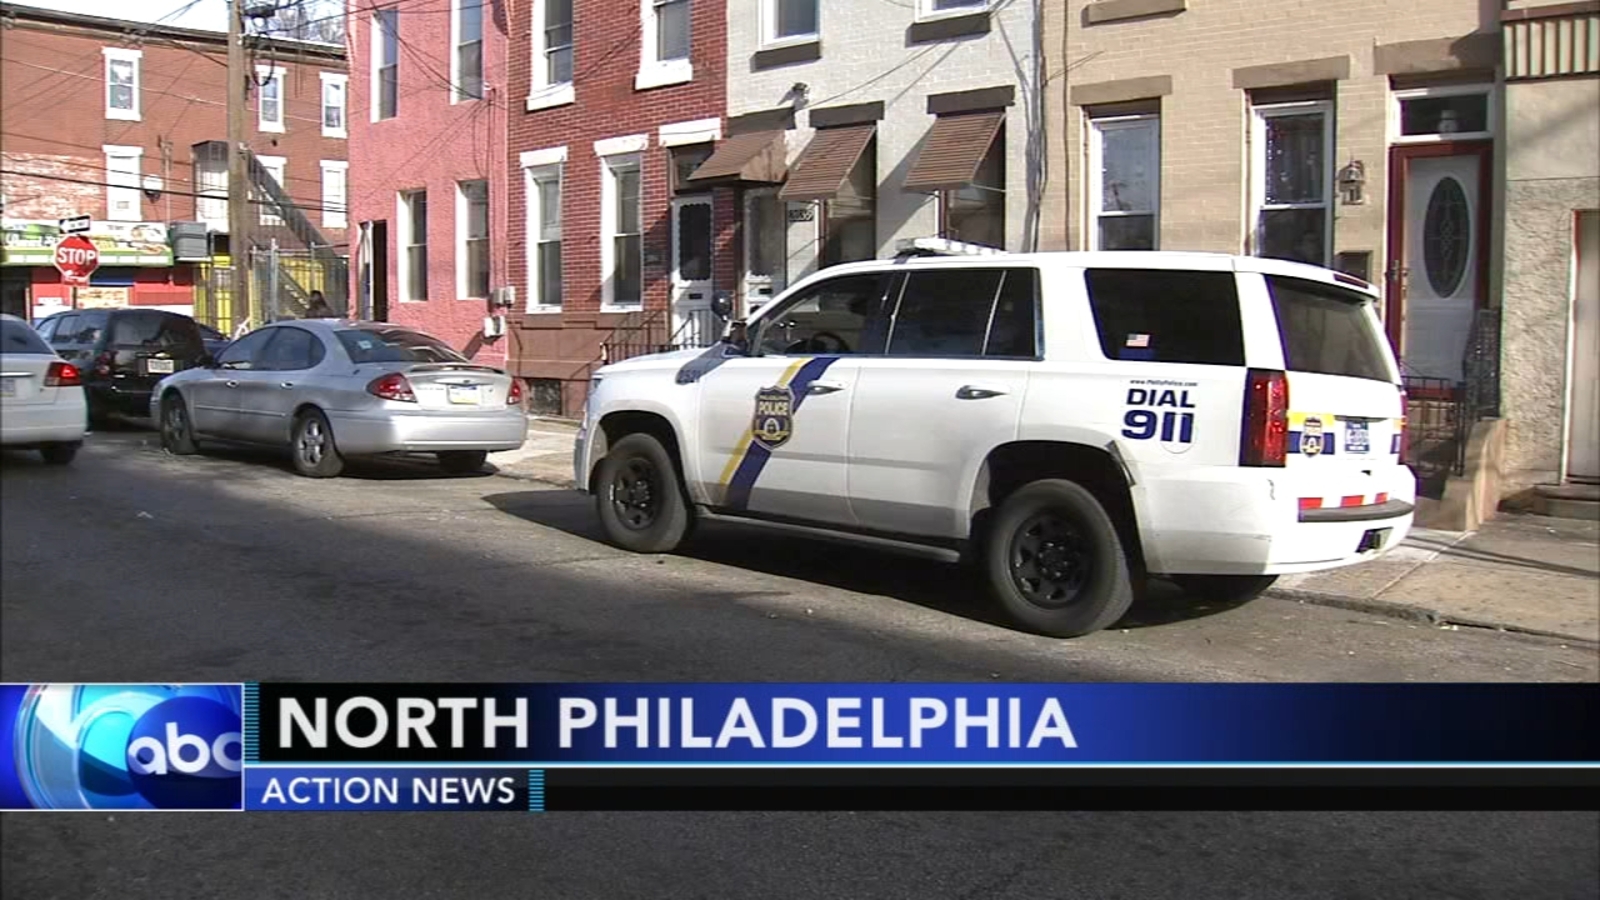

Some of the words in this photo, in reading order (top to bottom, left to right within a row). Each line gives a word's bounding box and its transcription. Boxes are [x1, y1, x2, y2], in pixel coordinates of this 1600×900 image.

[58, 247, 96, 265] STOP
[1126, 388, 1196, 408] DIAL
[759, 401, 788, 415] POLICE
[1121, 409, 1194, 443] 911
